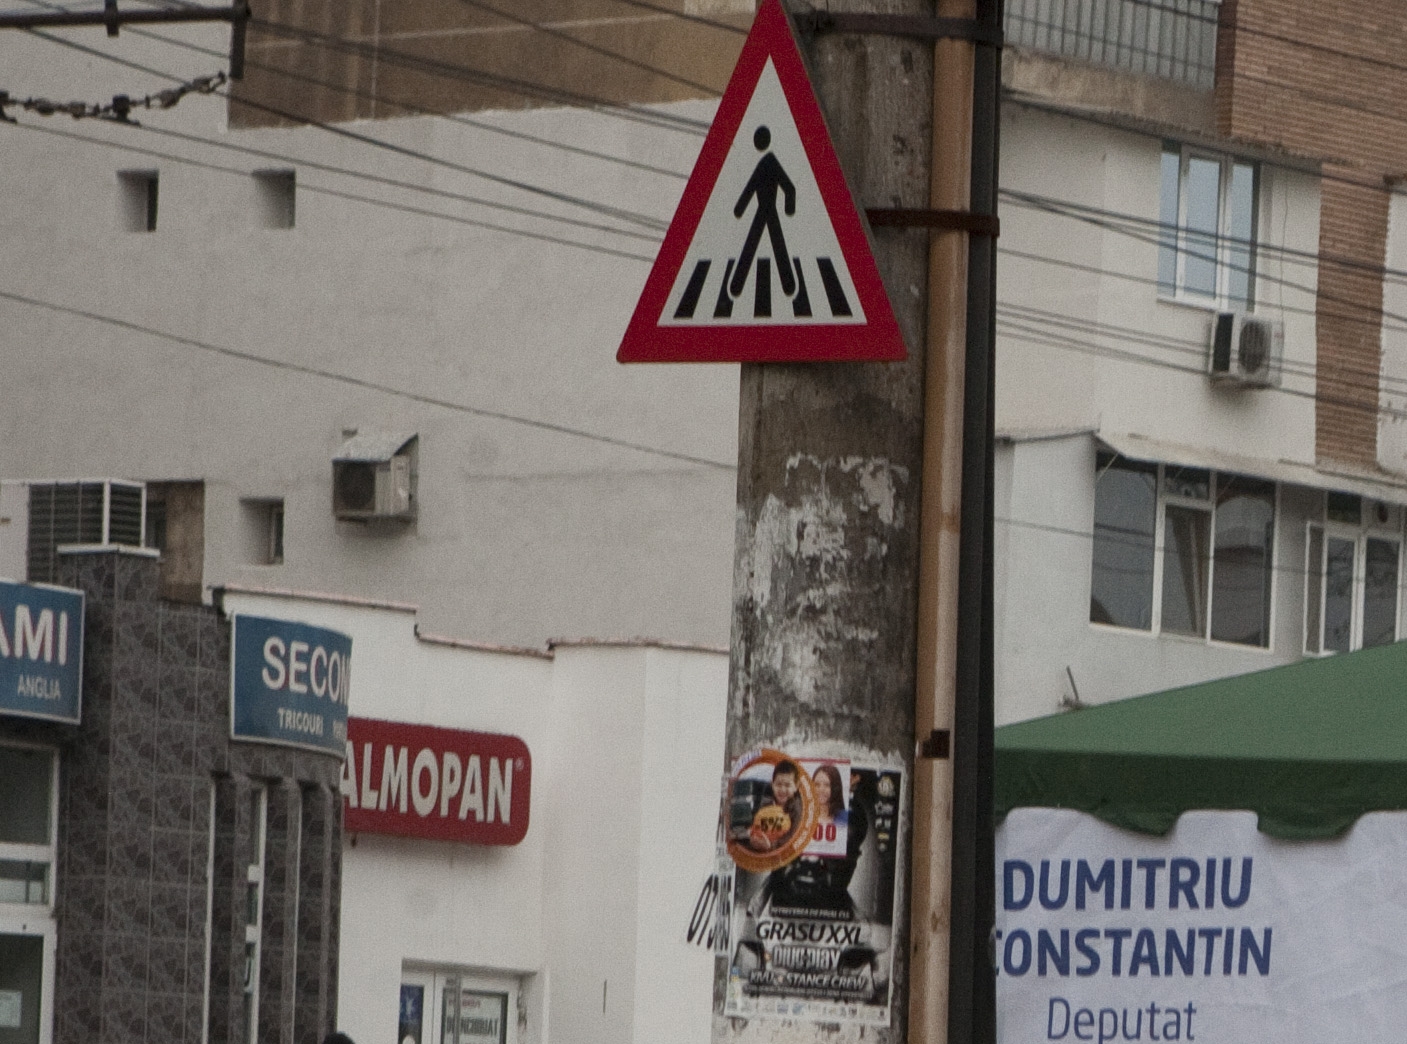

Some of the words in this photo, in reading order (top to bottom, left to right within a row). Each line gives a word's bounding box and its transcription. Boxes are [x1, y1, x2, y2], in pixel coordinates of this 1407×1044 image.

[17, 673, 62, 700] ANGLIA
[278, 706, 324, 738] TRICOURI
[1002, 856, 1254, 912] DUMITRIU
[756, 919, 826, 943] GRASU
[996, 926, 1273, 977] ONSTANTIN
